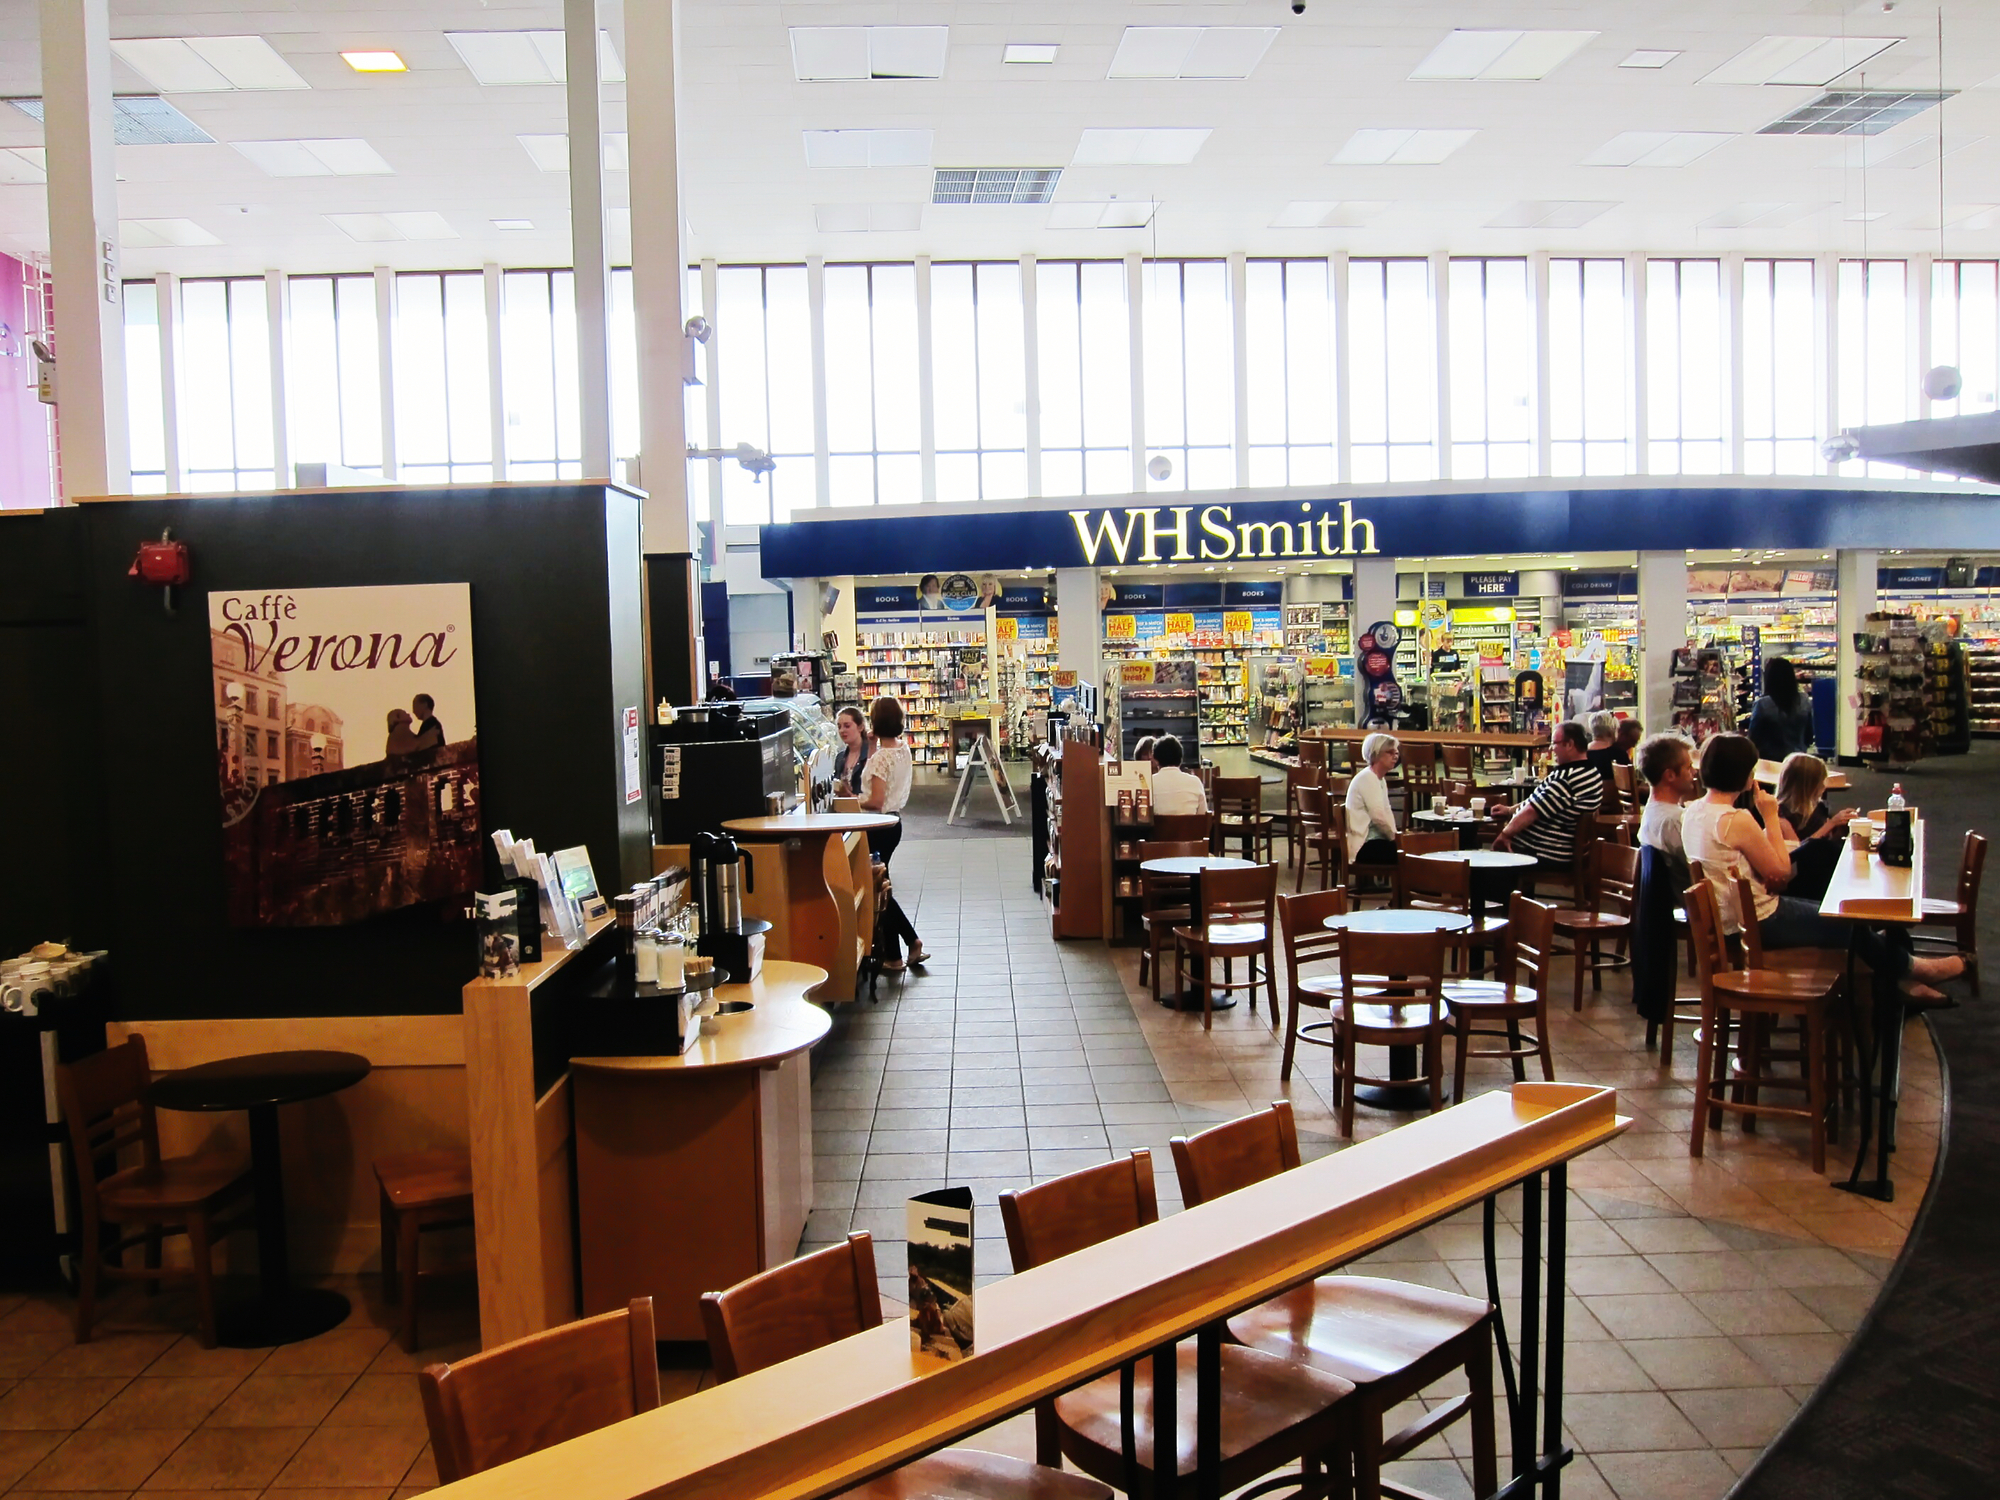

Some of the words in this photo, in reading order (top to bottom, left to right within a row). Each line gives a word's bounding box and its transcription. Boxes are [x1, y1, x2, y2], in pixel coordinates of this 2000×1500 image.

[1068, 500, 1380, 565] WHSmith
[1478, 584, 1505, 593] HERE
[222, 595, 297, 621] Caffè
[1109, 623, 1132, 631] HALF
[1121, 665, 1143, 673] Fancy
[1305, 662, 1312, 675] 5
[1324, 661, 1335, 678] 4
[1123, 673, 1147, 681] treat?
